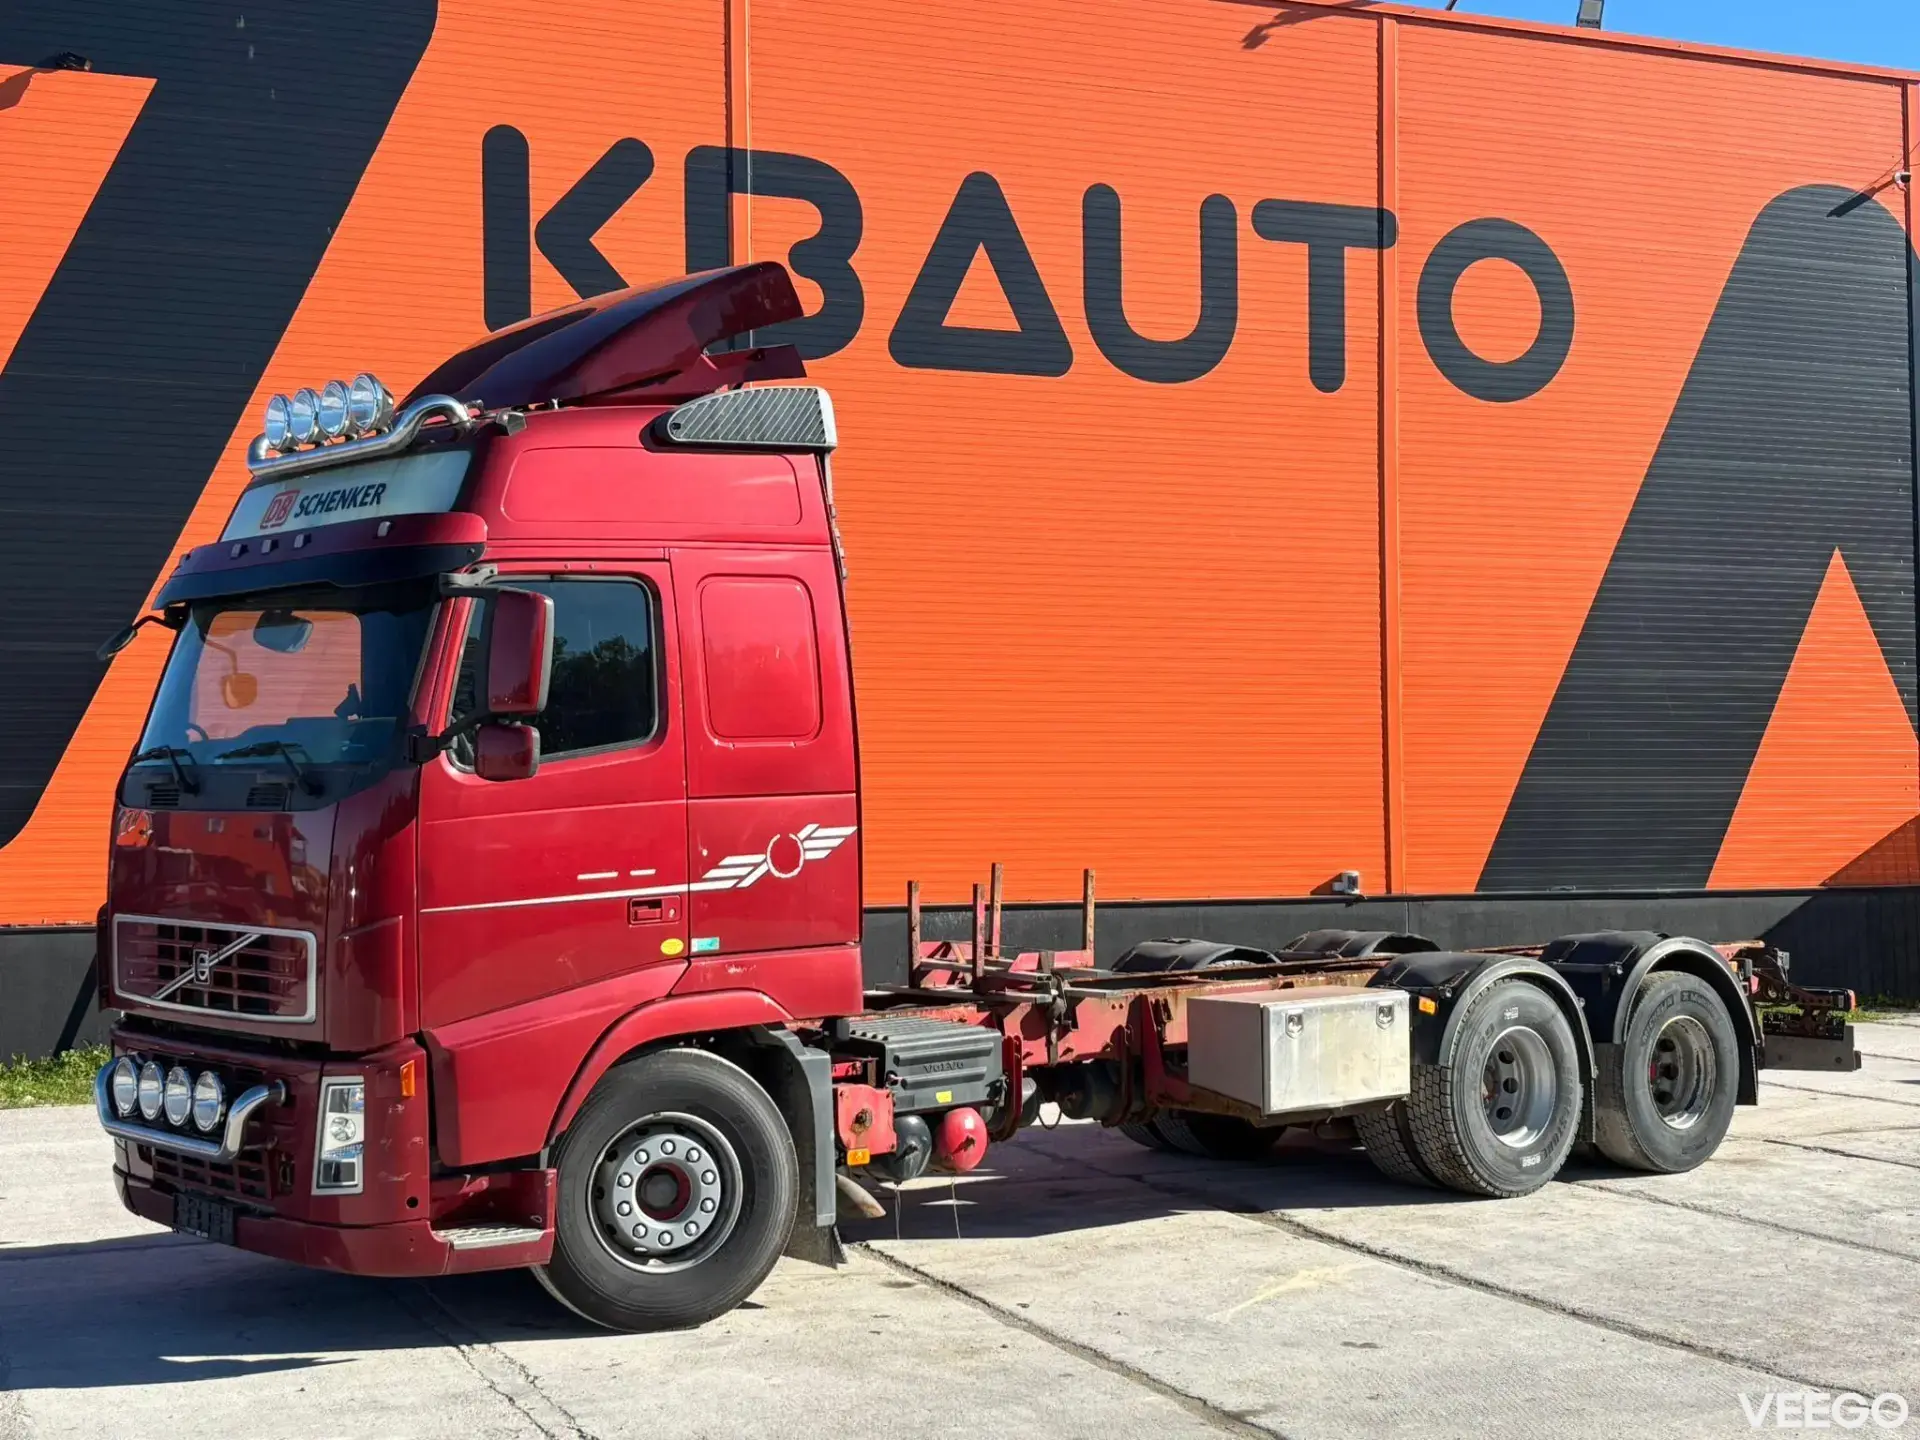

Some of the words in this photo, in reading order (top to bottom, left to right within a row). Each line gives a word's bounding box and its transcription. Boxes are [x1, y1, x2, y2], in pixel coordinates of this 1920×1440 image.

[481, 124, 1575, 402] KBAUTO
[262, 491, 298, 526] DB
[294, 483, 387, 519] SCHENKER
[923, 1060, 964, 1074] VOLVO
